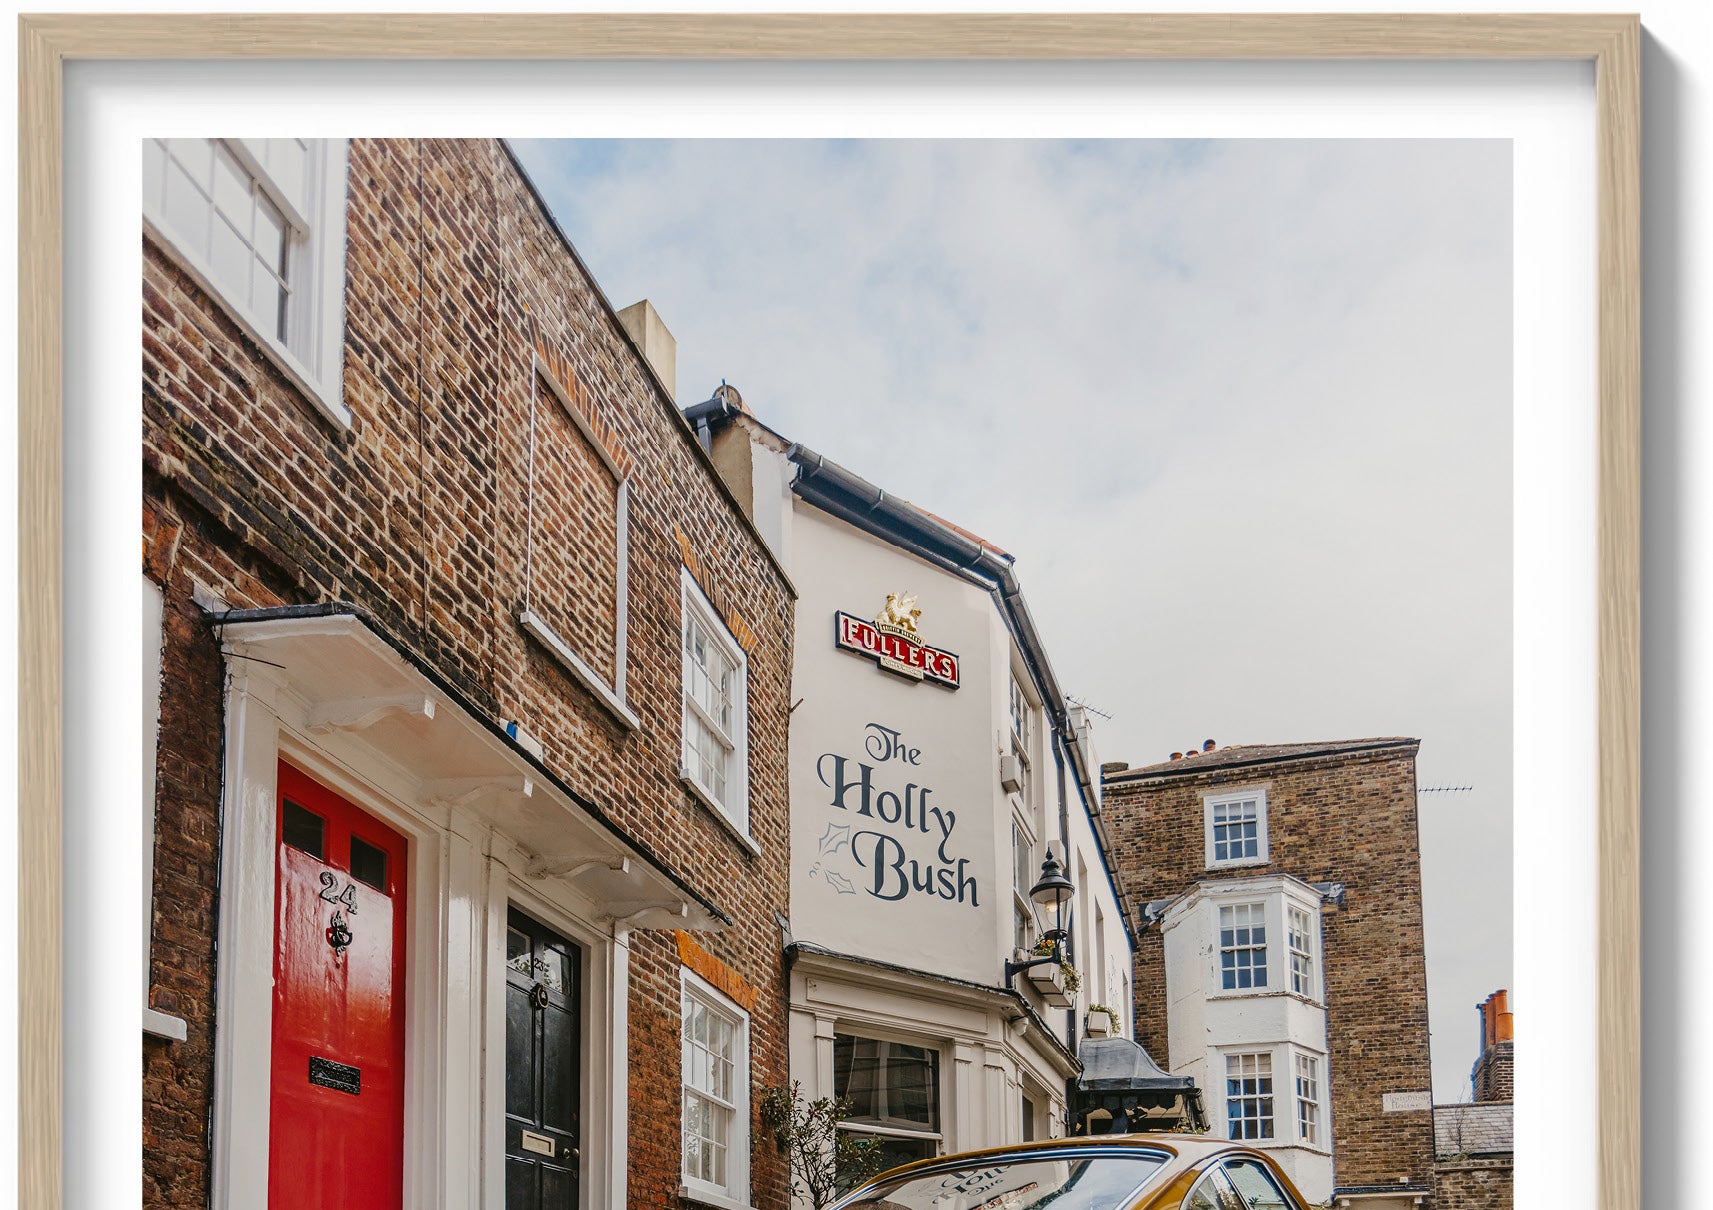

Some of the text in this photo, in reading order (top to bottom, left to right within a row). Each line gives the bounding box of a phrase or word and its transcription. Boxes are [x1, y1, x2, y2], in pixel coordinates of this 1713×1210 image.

[865, 722, 921, 766] The
[816, 753, 957, 865] Holly
[851, 830, 980, 907] Bush
[319, 871, 358, 915] 24
[534, 957, 544, 972] 23
